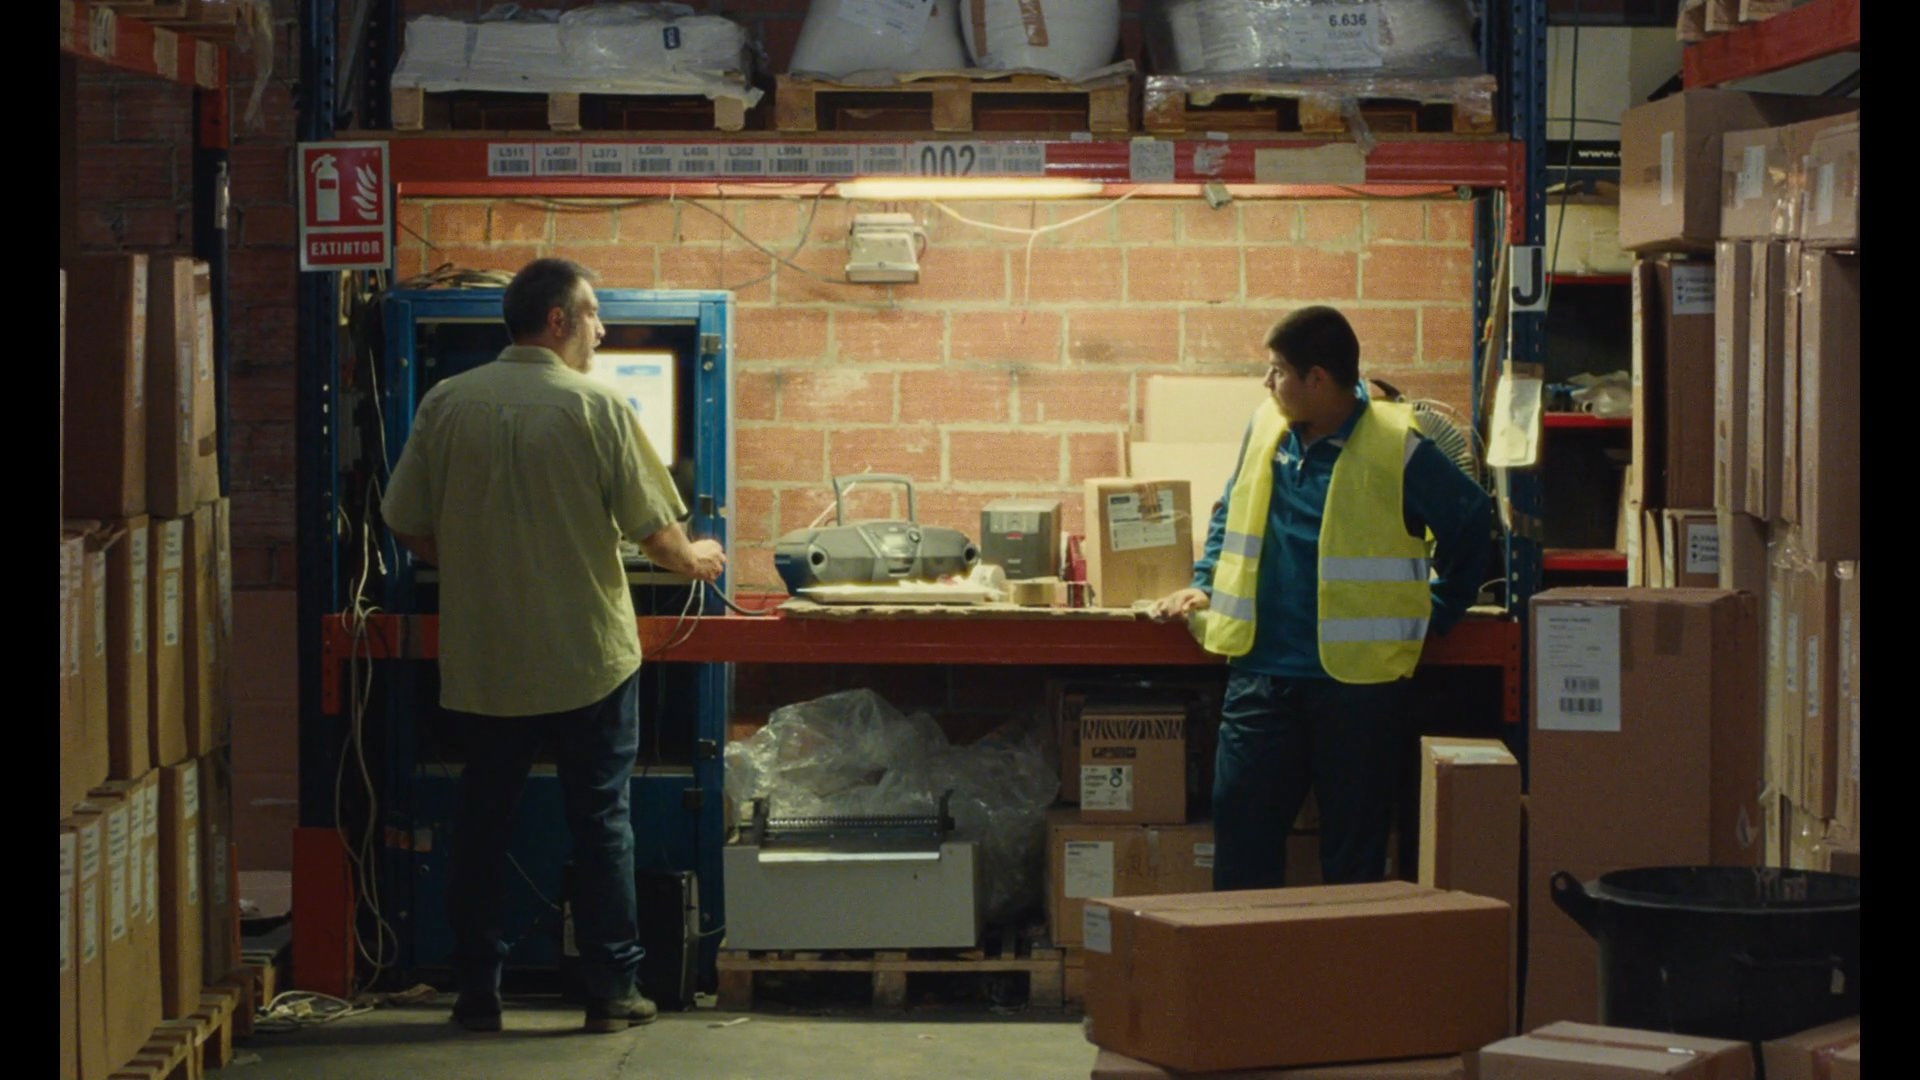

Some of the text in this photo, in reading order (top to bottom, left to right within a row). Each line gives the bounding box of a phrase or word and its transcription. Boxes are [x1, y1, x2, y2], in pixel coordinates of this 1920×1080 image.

[1578, 150, 1621, 159] www.
[311, 240, 380, 256] EXTINTOR
[1511, 247, 1543, 307] J
